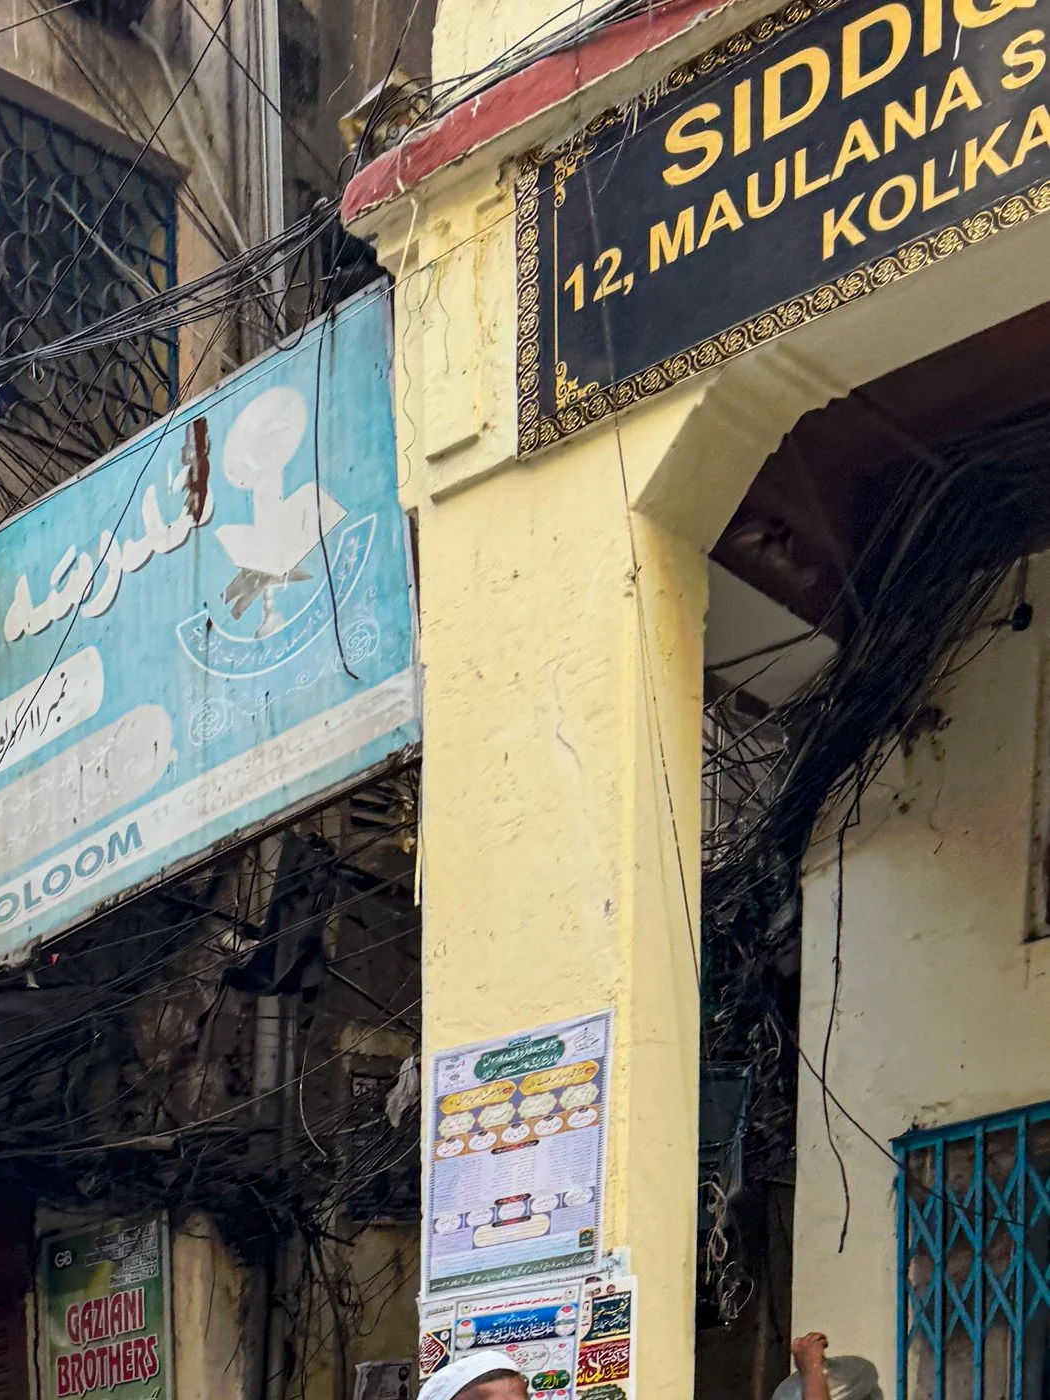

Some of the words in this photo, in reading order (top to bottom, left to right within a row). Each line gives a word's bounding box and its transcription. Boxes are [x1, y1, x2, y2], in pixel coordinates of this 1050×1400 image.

[563, 246, 636, 312] 12,
[649, 66, 983, 273] MAULANA
[822, 103, 1050, 262] KOLKA
[56, 1334, 160, 1397] BROTHERS
[66, 1287, 146, 1348] GAZIANI
